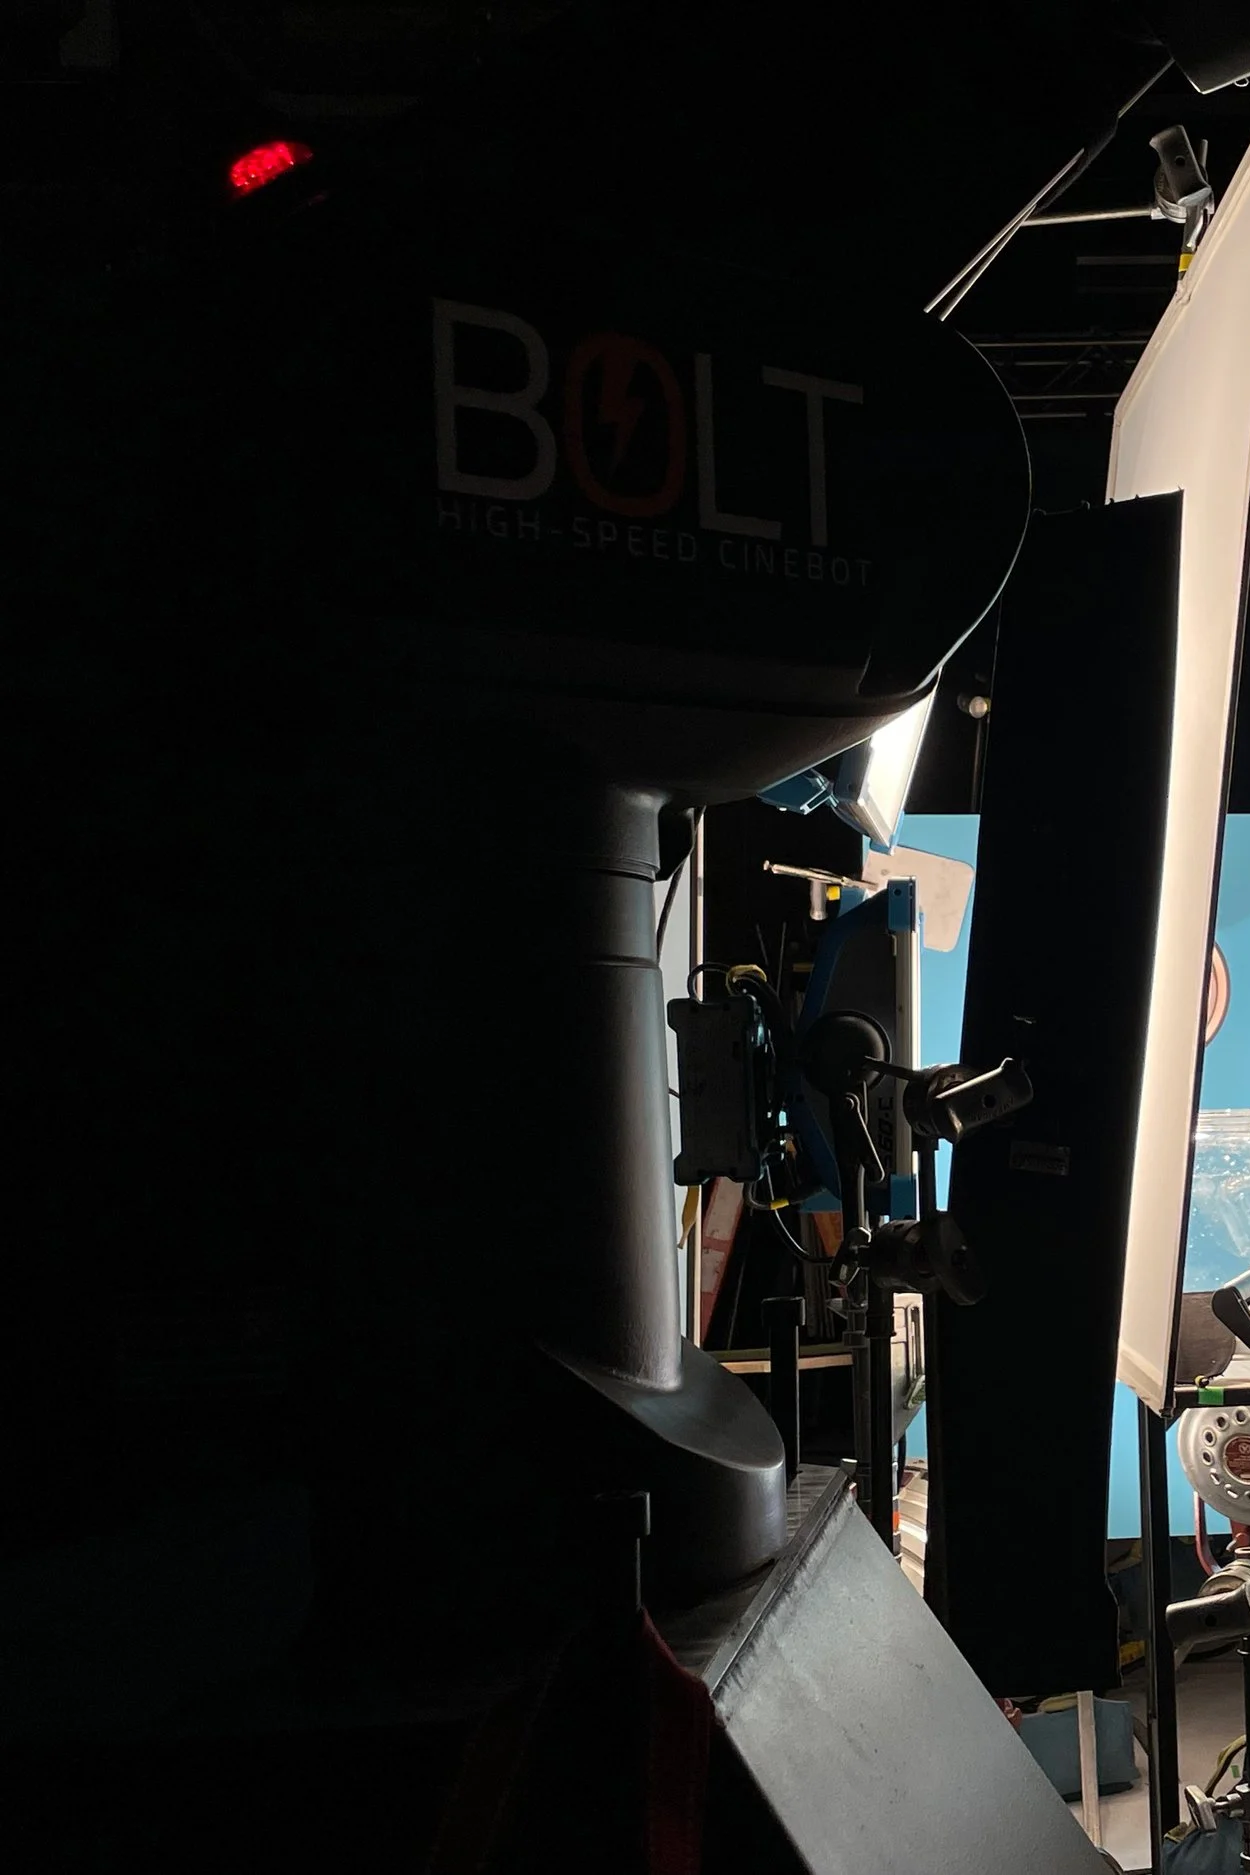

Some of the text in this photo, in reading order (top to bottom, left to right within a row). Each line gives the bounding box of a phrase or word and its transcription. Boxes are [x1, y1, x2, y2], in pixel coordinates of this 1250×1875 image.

[432, 296, 865, 548] BOLT
[436, 498, 873, 587] HIGH-SPEED CINEBOT
